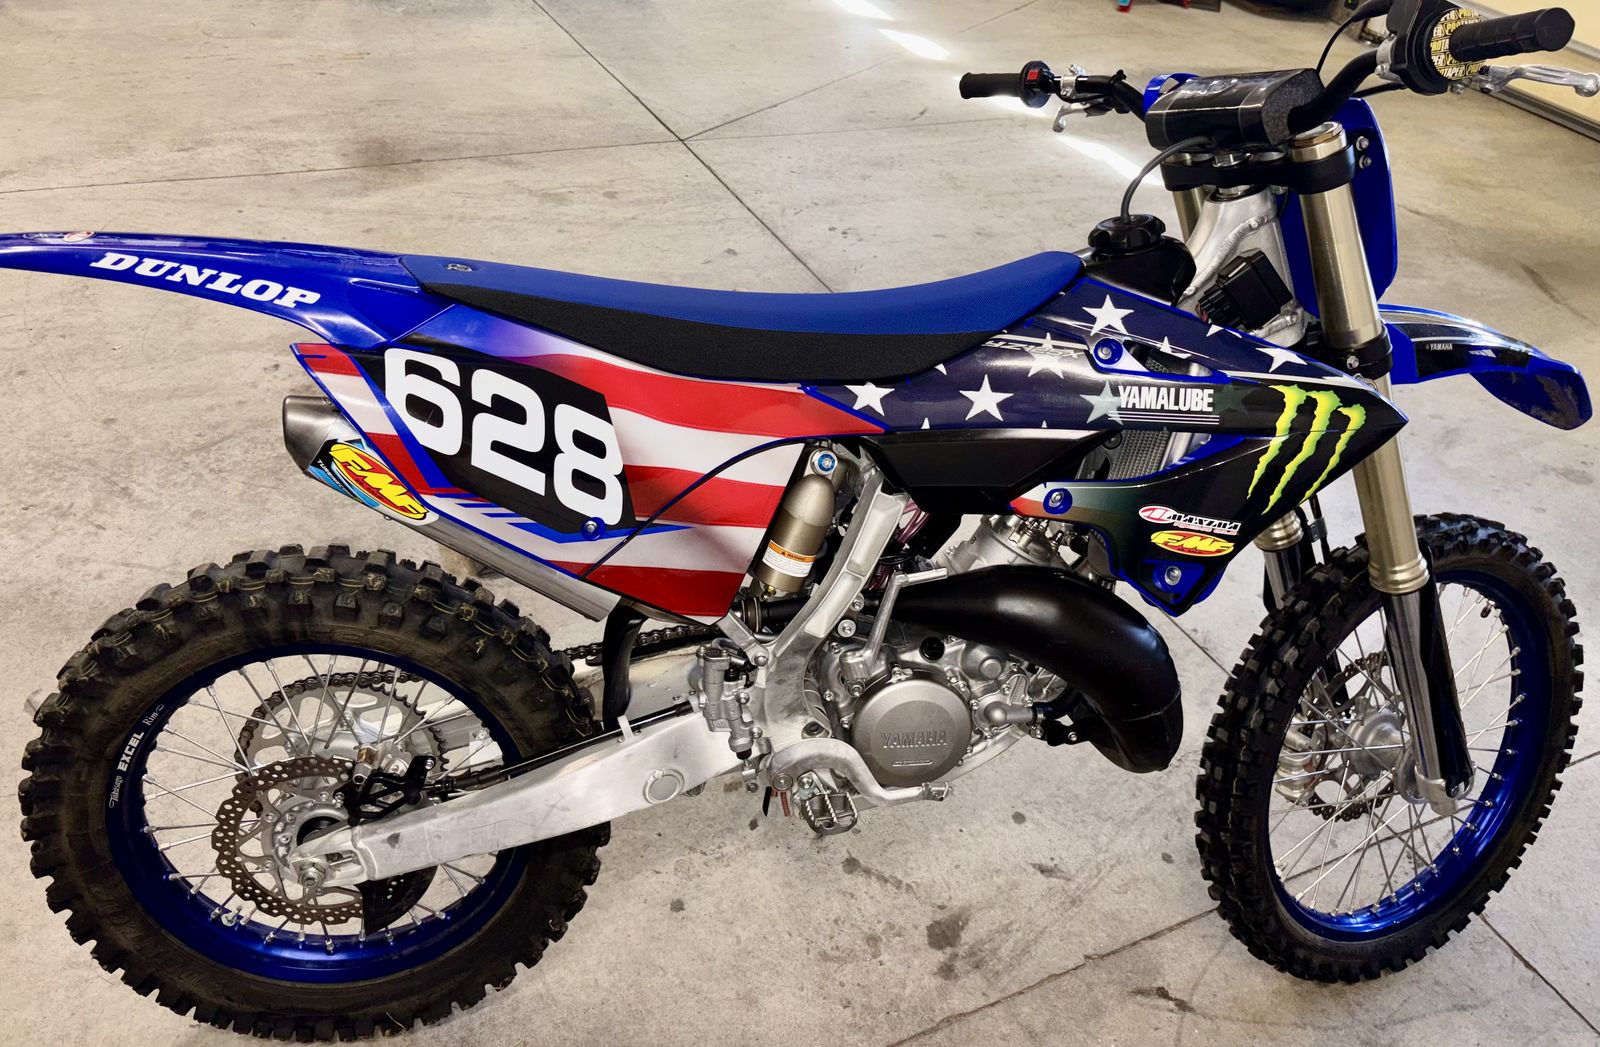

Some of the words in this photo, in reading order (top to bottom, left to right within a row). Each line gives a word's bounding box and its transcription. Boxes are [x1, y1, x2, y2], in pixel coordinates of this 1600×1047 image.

[89, 252, 321, 308] DUNLOP
[1430, 343, 1453, 351] YAMAHA
[1118, 385, 1214, 412] YAMALUBE
[384, 348, 624, 526] 628
[329, 447, 430, 515] FMF
[1151, 532, 1236, 552] FMF
[117, 732, 145, 772] EXCEL
[142, 704, 164, 726] Rim
[881, 730, 948, 748] YAMAHA
